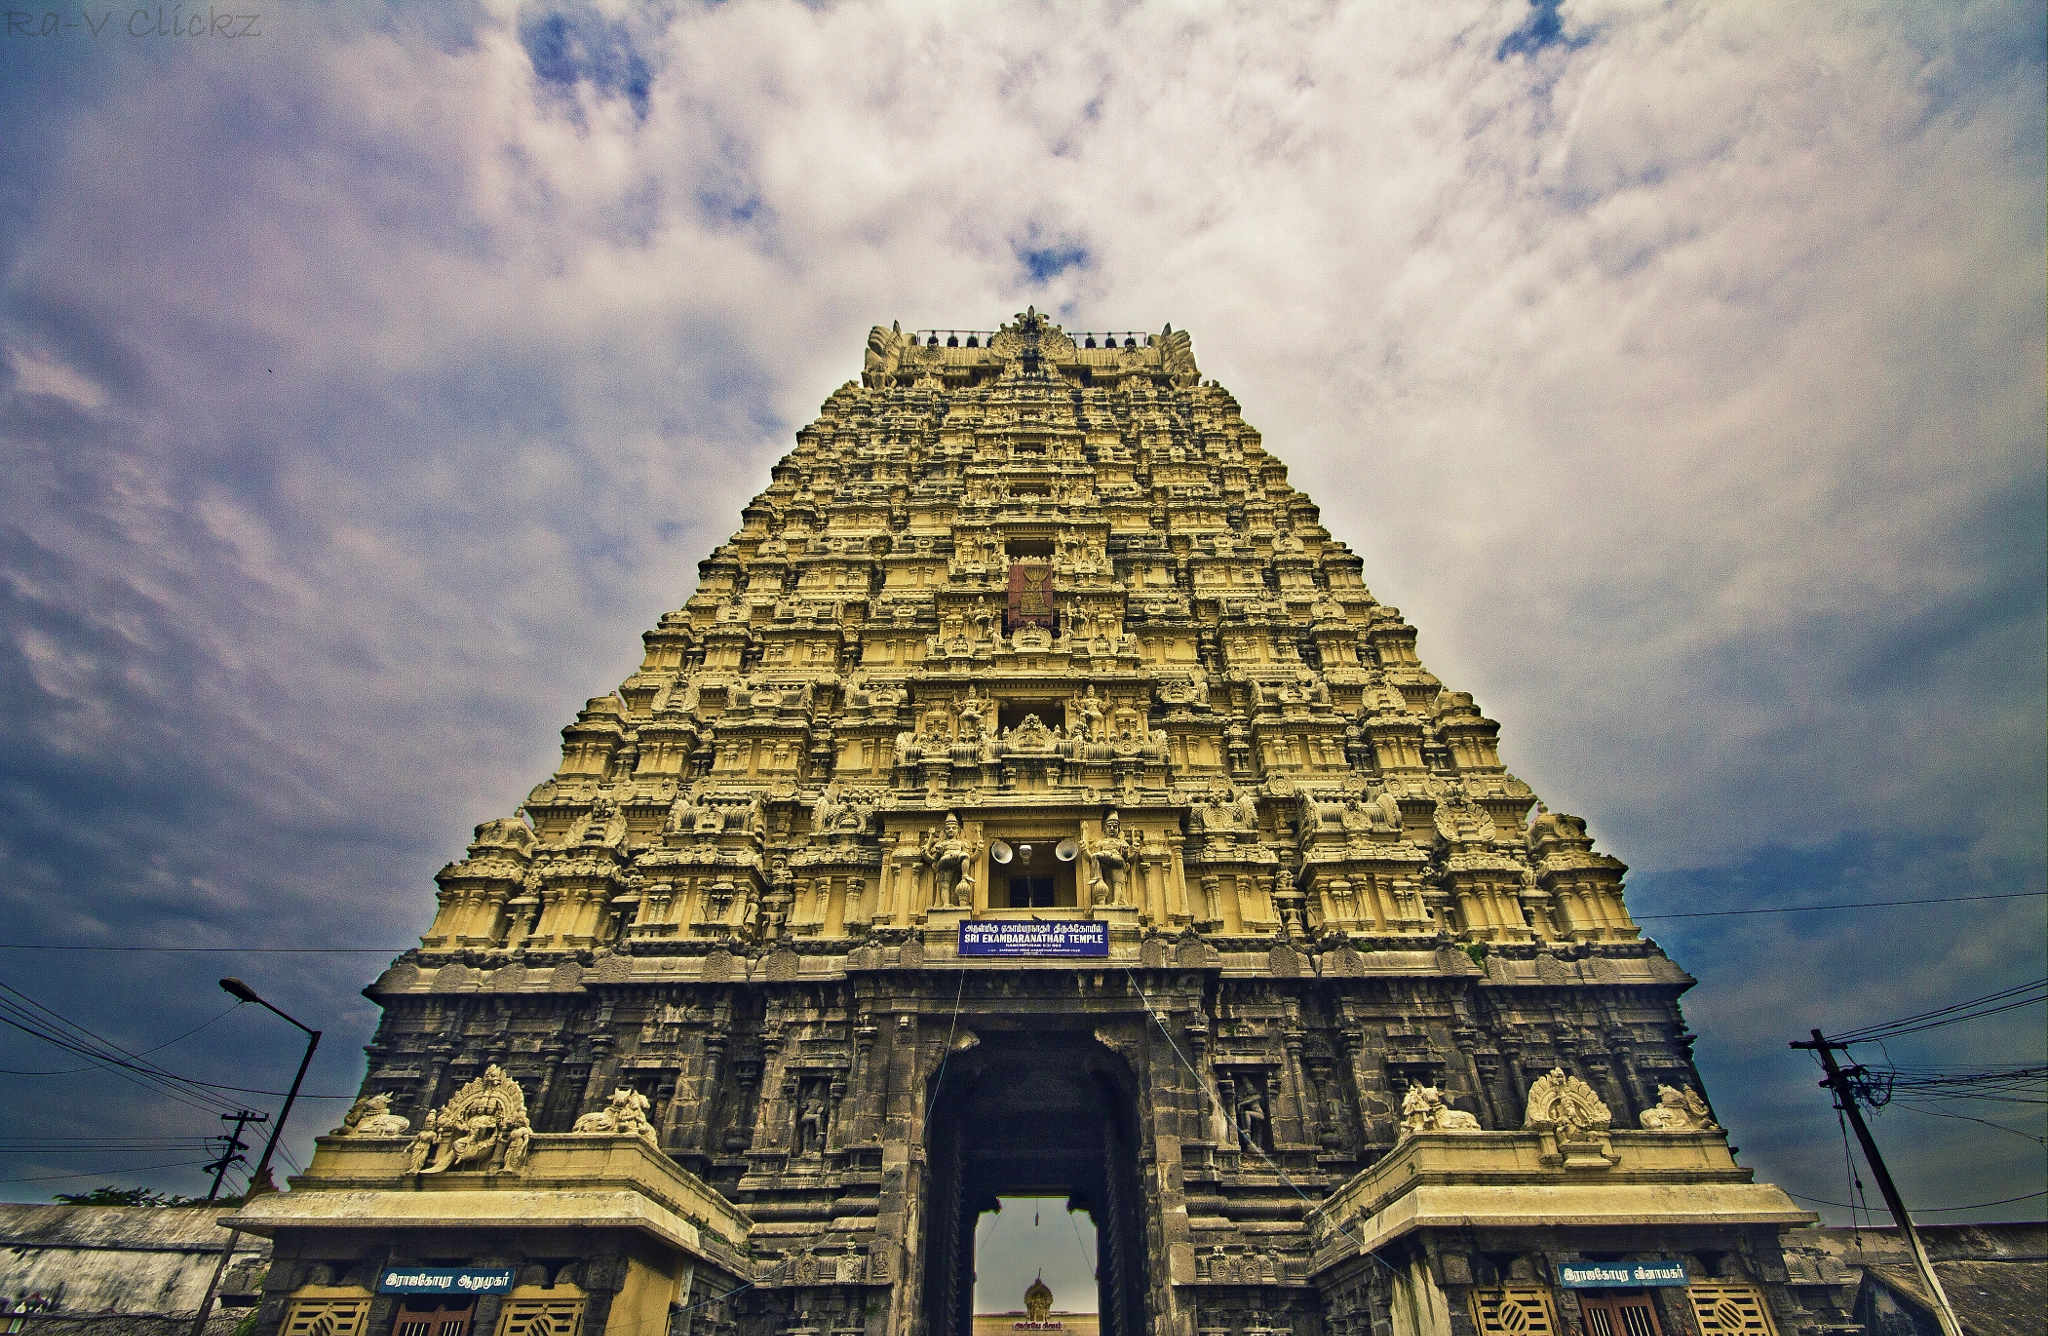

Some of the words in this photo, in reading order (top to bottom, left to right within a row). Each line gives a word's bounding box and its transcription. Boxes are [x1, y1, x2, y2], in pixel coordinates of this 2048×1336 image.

[964, 934, 979, 943] SRI
[982, 934, 1065, 943] EKAMBARANATHAR
[1068, 934, 1104, 943] TEMPLE
[385, 1272, 453, 1289] இராஜகோபுர
[457, 1271, 509, 1290] ஆறுமுகர்
[1563, 1267, 1629, 1283] இராஜகோபுர
